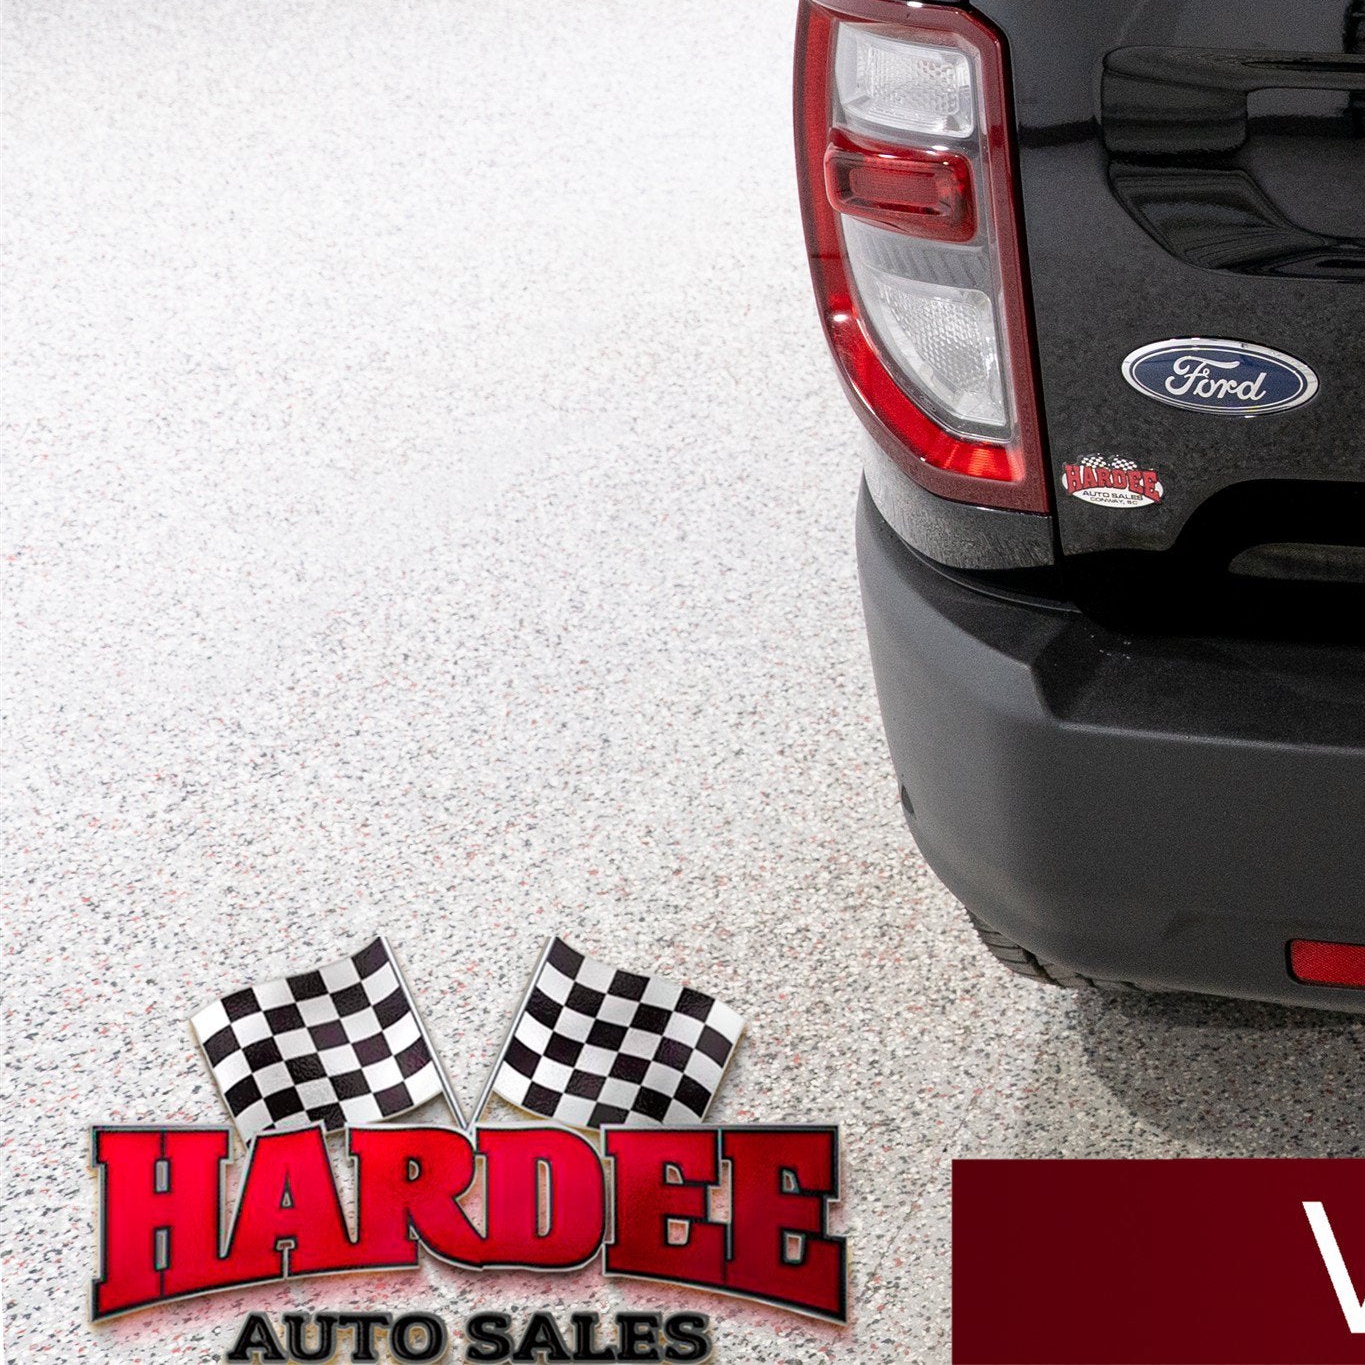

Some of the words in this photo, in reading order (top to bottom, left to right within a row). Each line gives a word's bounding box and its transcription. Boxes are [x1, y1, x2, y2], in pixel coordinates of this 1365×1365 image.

[1164, 355, 1267, 401] Ford
[1064, 464, 1161, 504] HARDEE
[1083, 490, 1110, 498] AUTO
[1111, 492, 1144, 502] SALES
